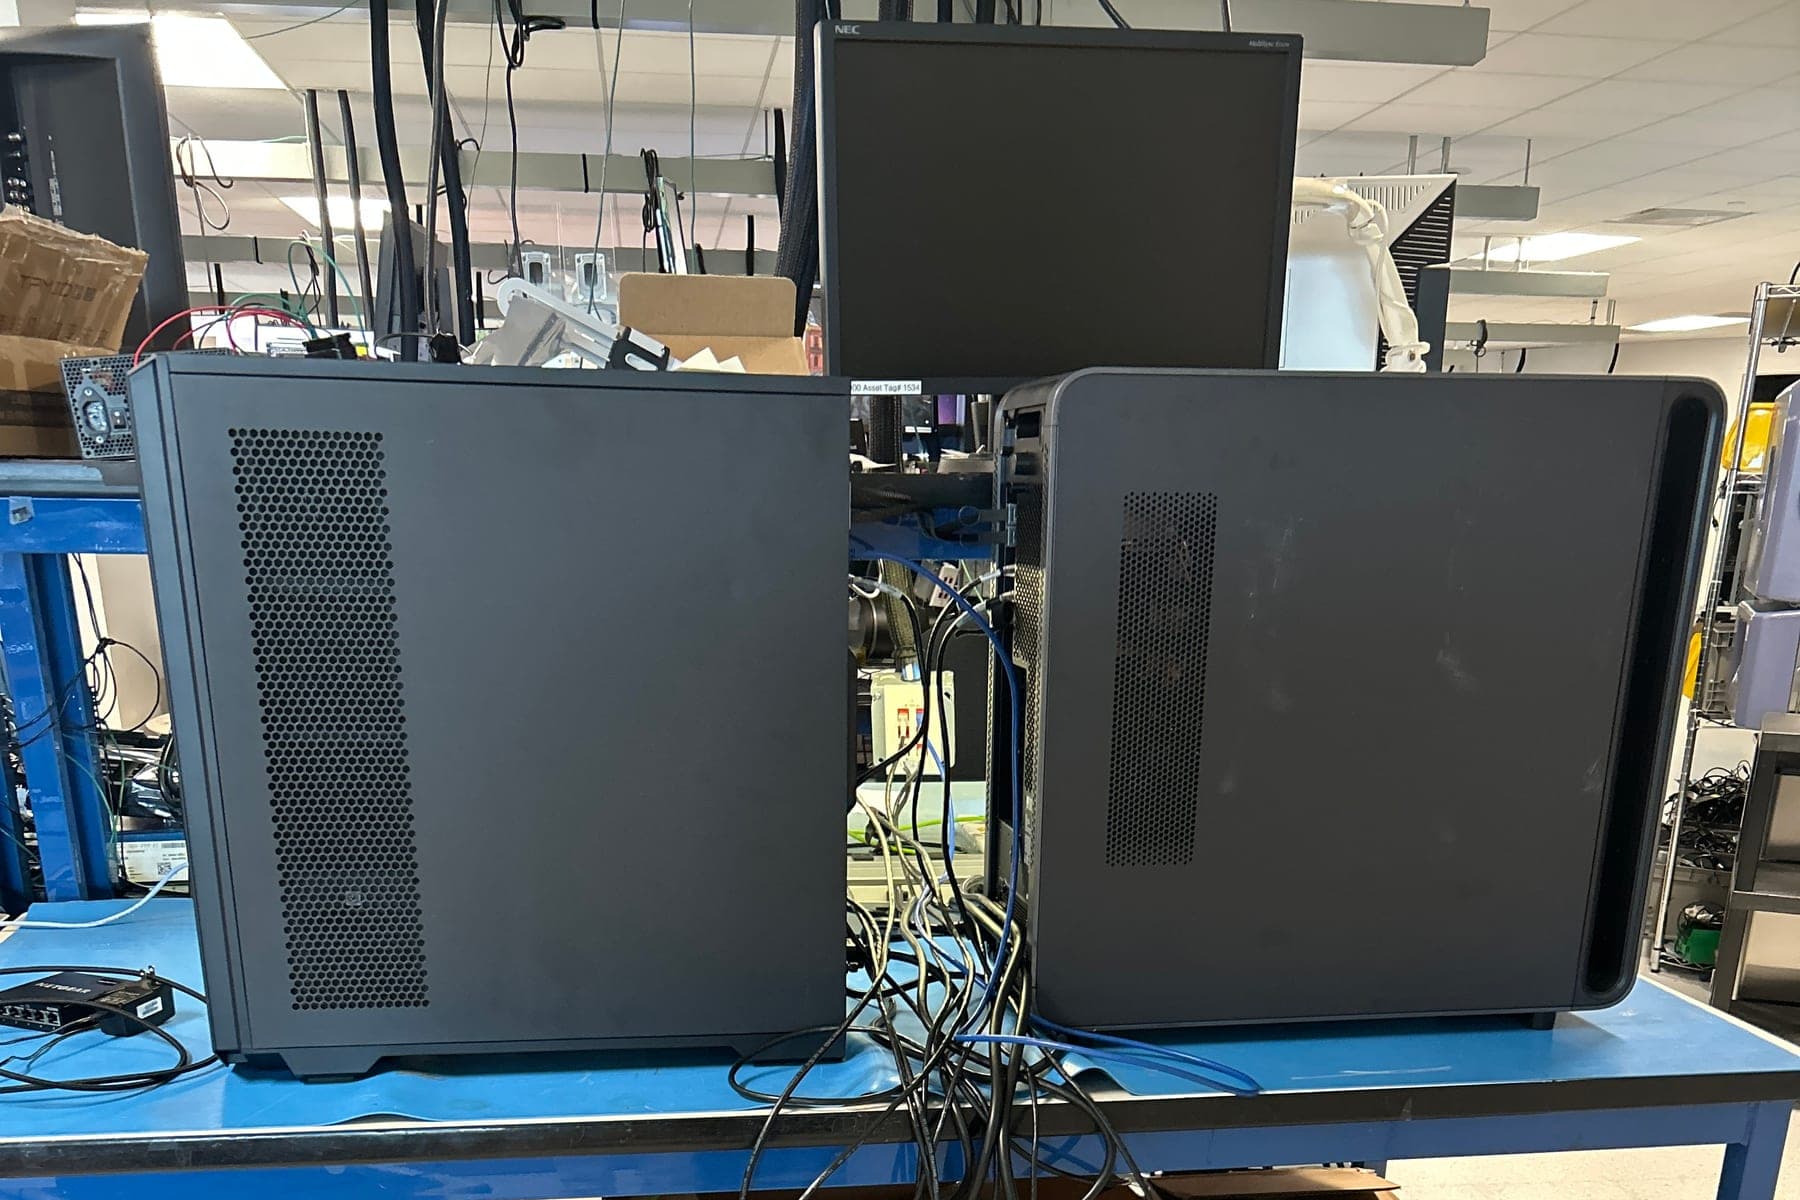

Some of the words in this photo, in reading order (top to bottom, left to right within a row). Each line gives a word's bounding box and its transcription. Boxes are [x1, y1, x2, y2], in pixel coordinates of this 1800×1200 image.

[834, 24, 861, 35] NEC
[862, 383, 883, 392] Asset
[883, 383, 902, 393] Tag#
[903, 383, 920, 392] 1534
